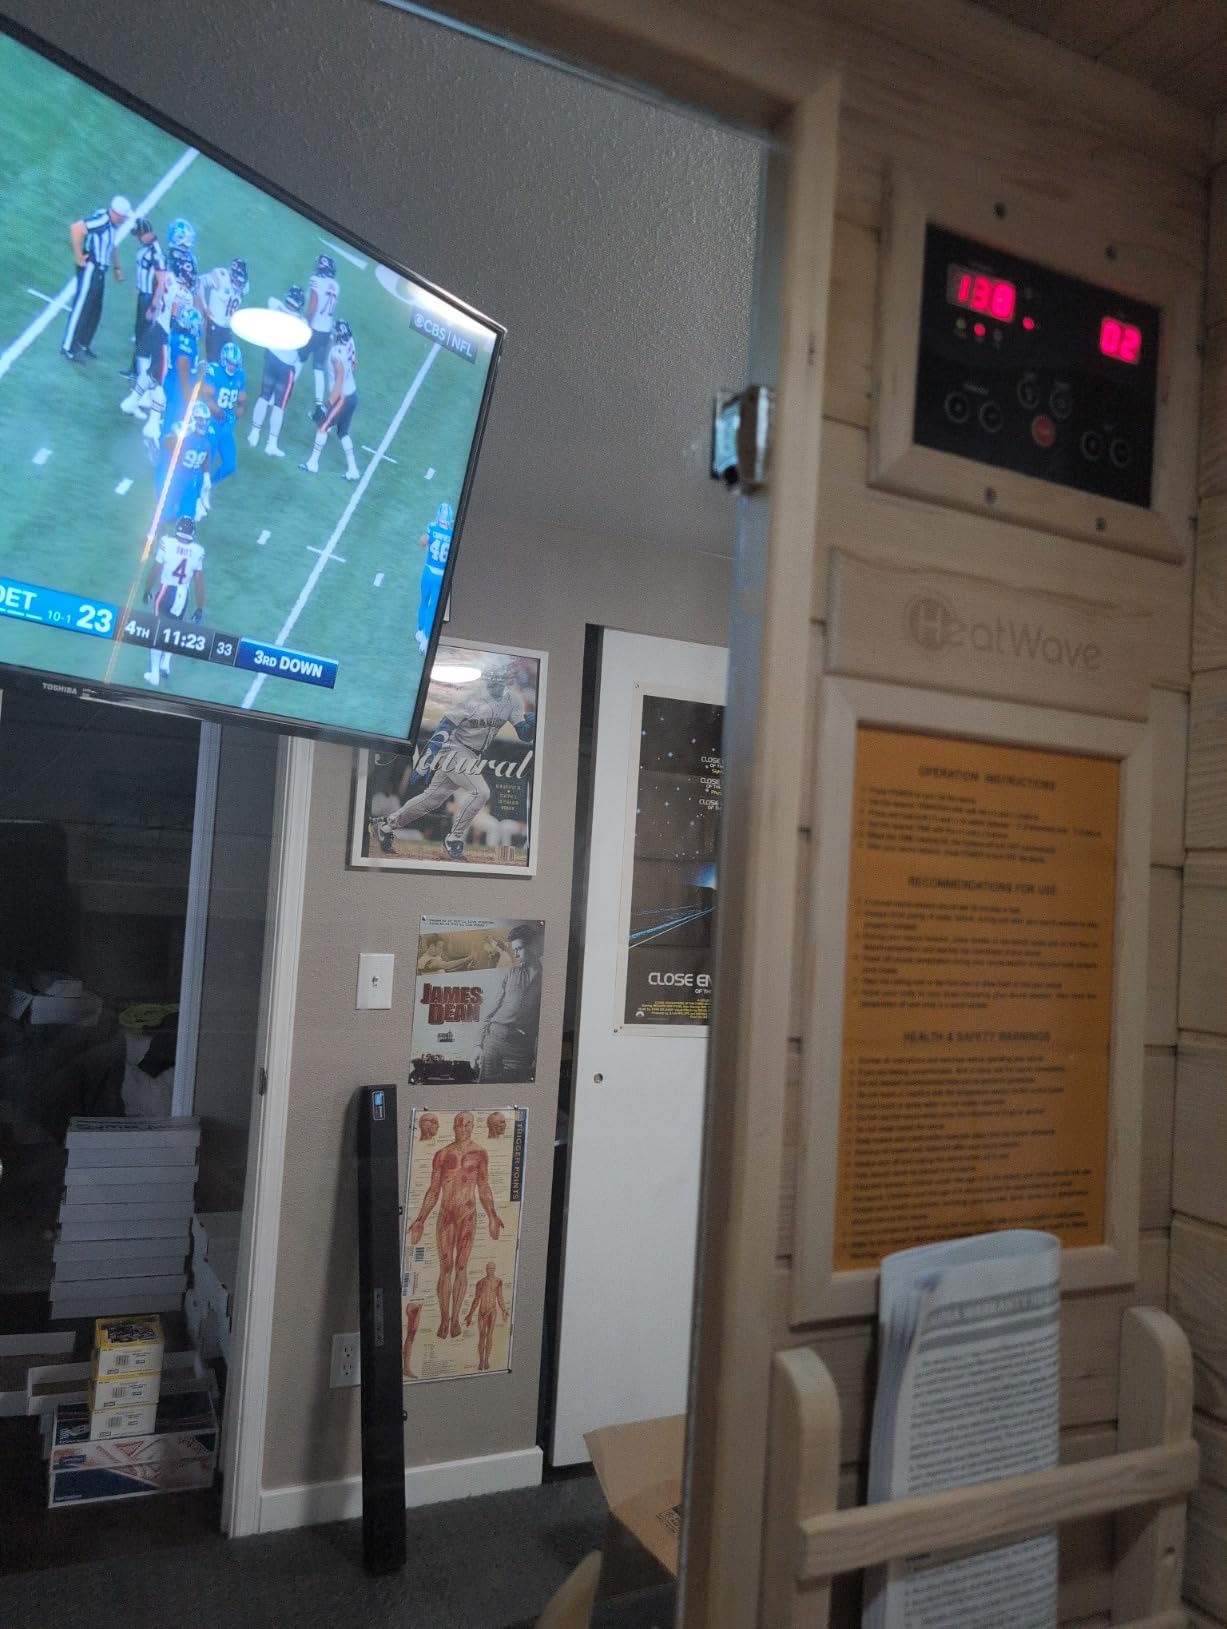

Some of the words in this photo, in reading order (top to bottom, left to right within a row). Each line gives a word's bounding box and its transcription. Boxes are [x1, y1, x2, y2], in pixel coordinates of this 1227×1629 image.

[423, 319, 446, 341] CBS
[451, 334, 473, 358] NFL
[1099, 317, 1142, 363] 02
[172, 558, 187, 585] 4
[47, 609, 72, 625] 10-1
[77, 605, 114, 633] 23
[124, 620, 151, 640] 4TH
[162, 628, 207, 651] 11:23
[216, 642, 232, 656] 33
[254, 649, 278, 668] 3RD
[279, 653, 323, 677] DOWN
[42, 682, 78, 695] TOSHIBA
[648, 972, 694, 986] CLOSE
[420, 983, 484, 1005] JAMES
[427, 1003, 480, 1025] DEAN
[514, 1122, 524, 1166] TRIGGER
